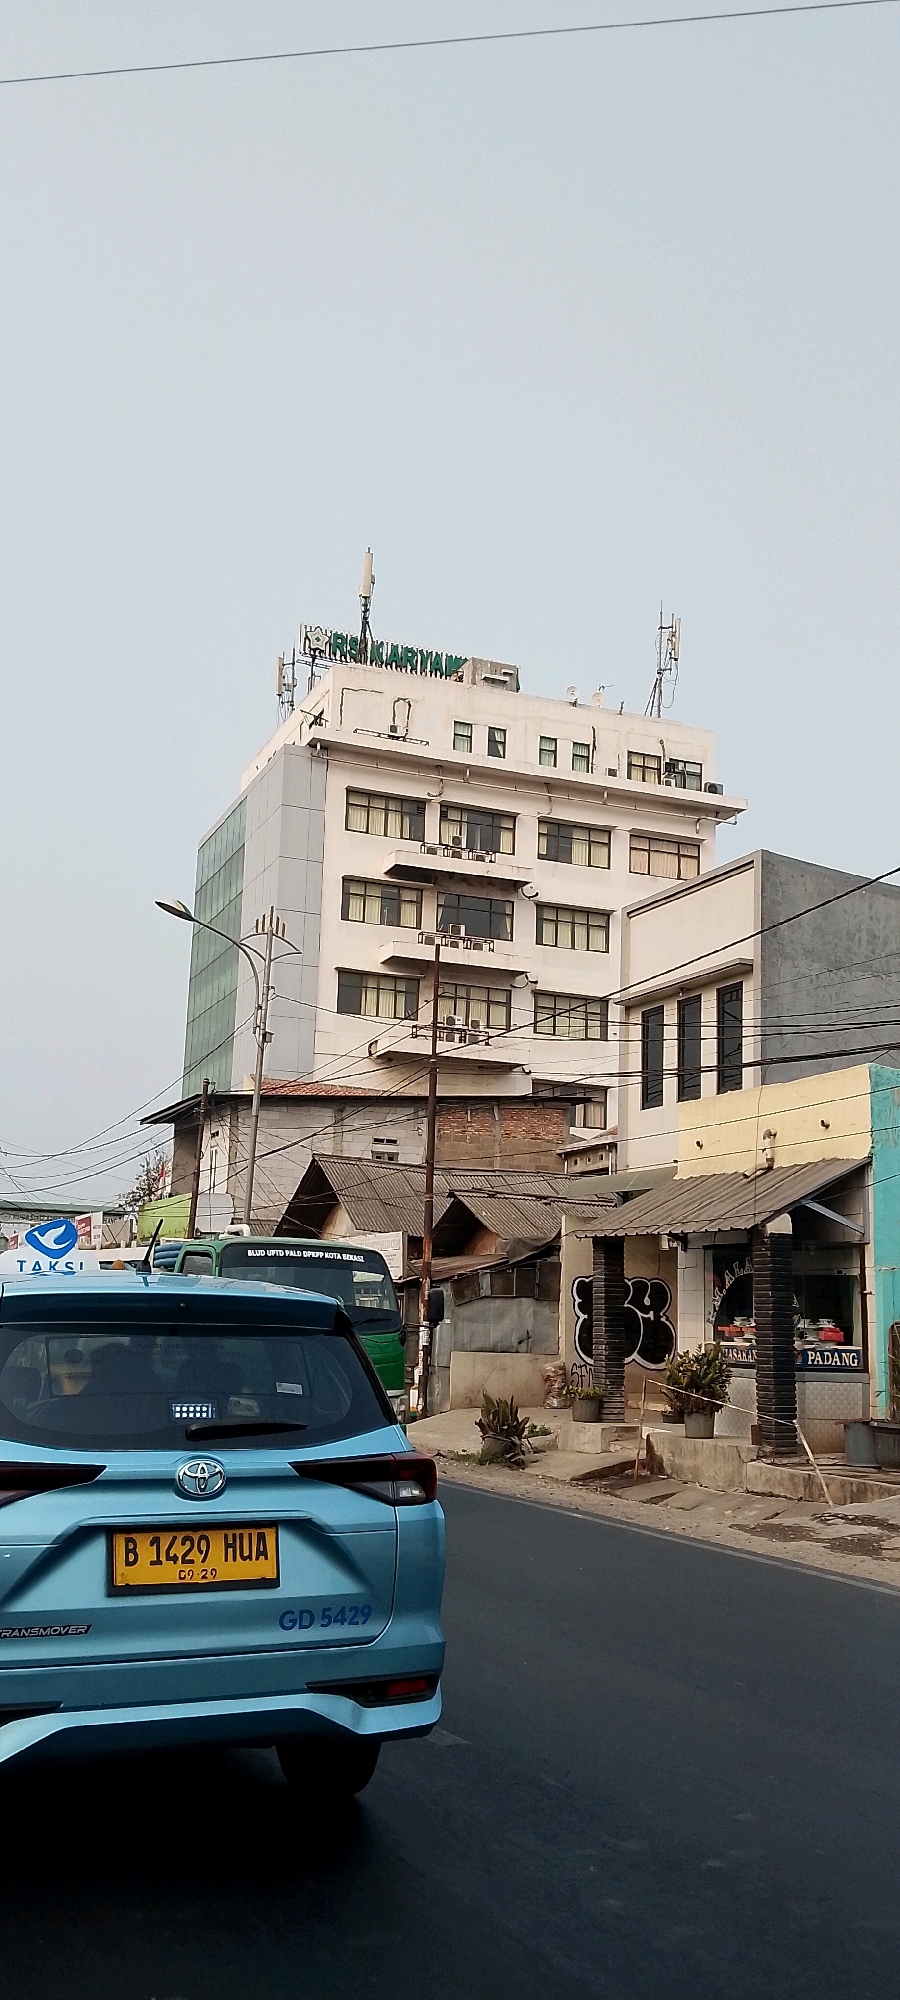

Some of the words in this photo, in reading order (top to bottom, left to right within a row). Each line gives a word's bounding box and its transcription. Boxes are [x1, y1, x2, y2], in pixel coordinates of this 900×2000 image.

[332, 632, 359, 659] RS
[17, 1260, 84, 1272] TAKSI
[247, 1249, 265, 1257] BLUD
[285, 1250, 302, 1258] PALD
[325, 1252, 342, 1260] KOTA
[342, 1253, 365, 1263] BEKASI
[807, 1351, 858, 1366] PADANG
[124, 1537, 139, 1567] B
[149, 1534, 211, 1566] 1429
[224, 1532, 269, 1562] HUA
[279, 1609, 315, 1631] GD
[320, 1604, 373, 1627] 5429
